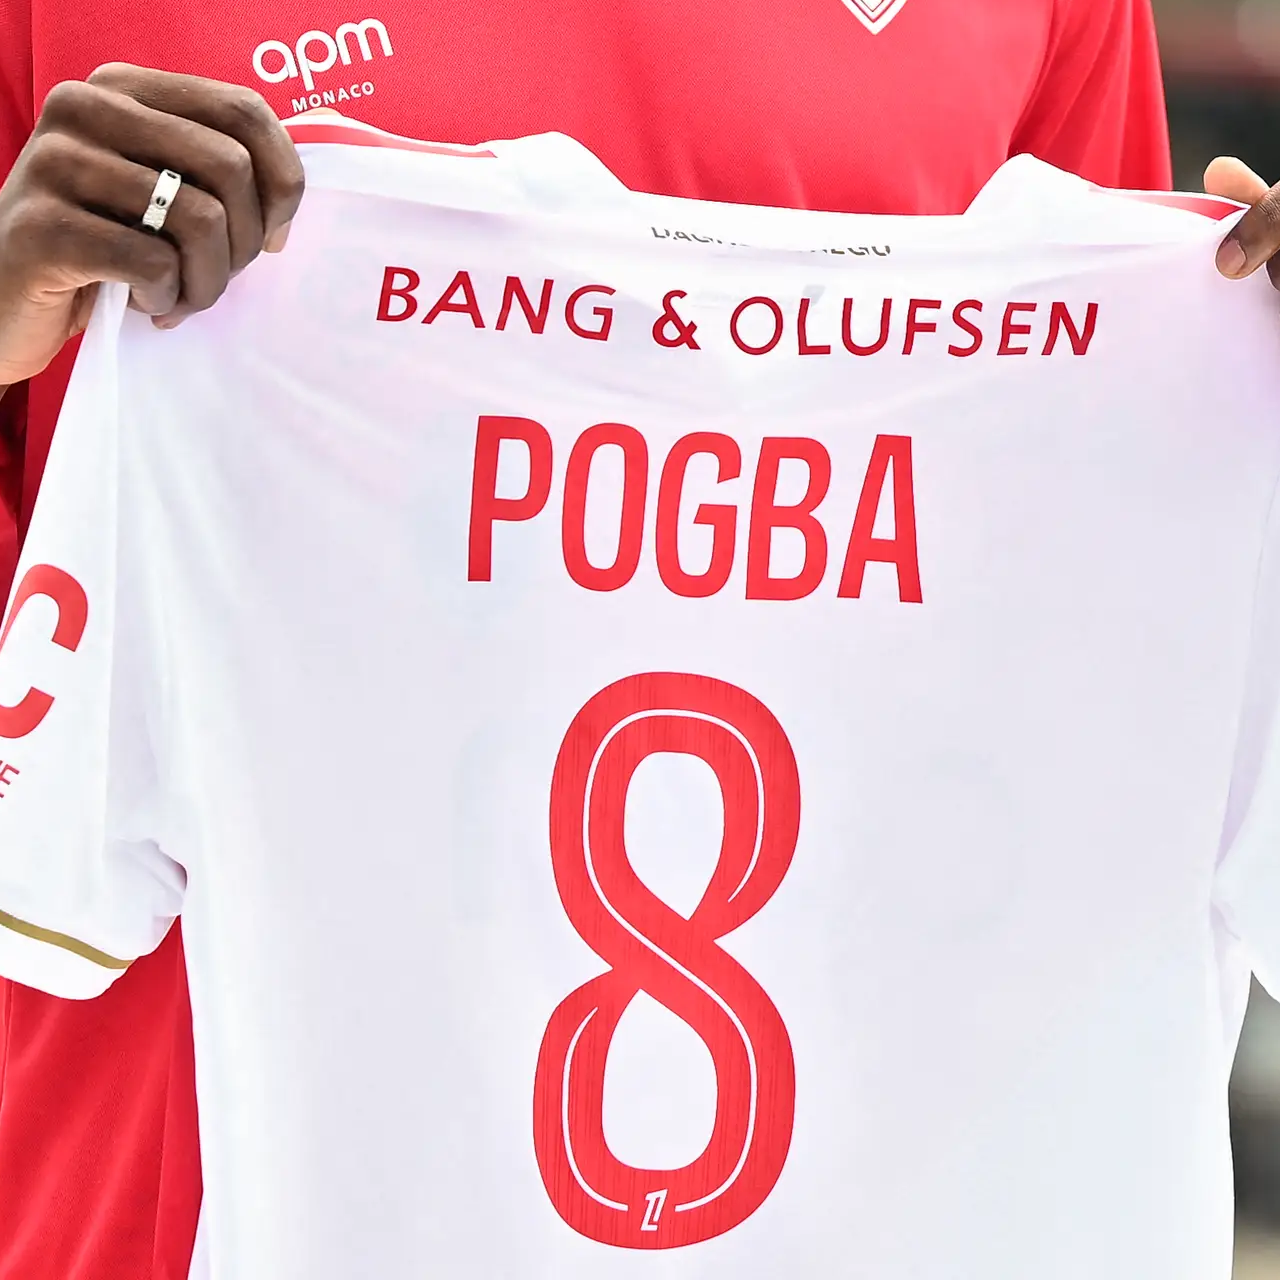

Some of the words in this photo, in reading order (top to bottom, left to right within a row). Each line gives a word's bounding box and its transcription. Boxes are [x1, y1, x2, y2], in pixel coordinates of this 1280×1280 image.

[252, 18, 394, 91] apm
[291, 81, 375, 113] MONACO
[376, 265, 617, 342] BANG
[651, 289, 701, 351] &
[729, 295, 1099, 358] OLUFSEN
[467, 414, 924, 605] POGBA
[532, 671, 802, 1250] 8
